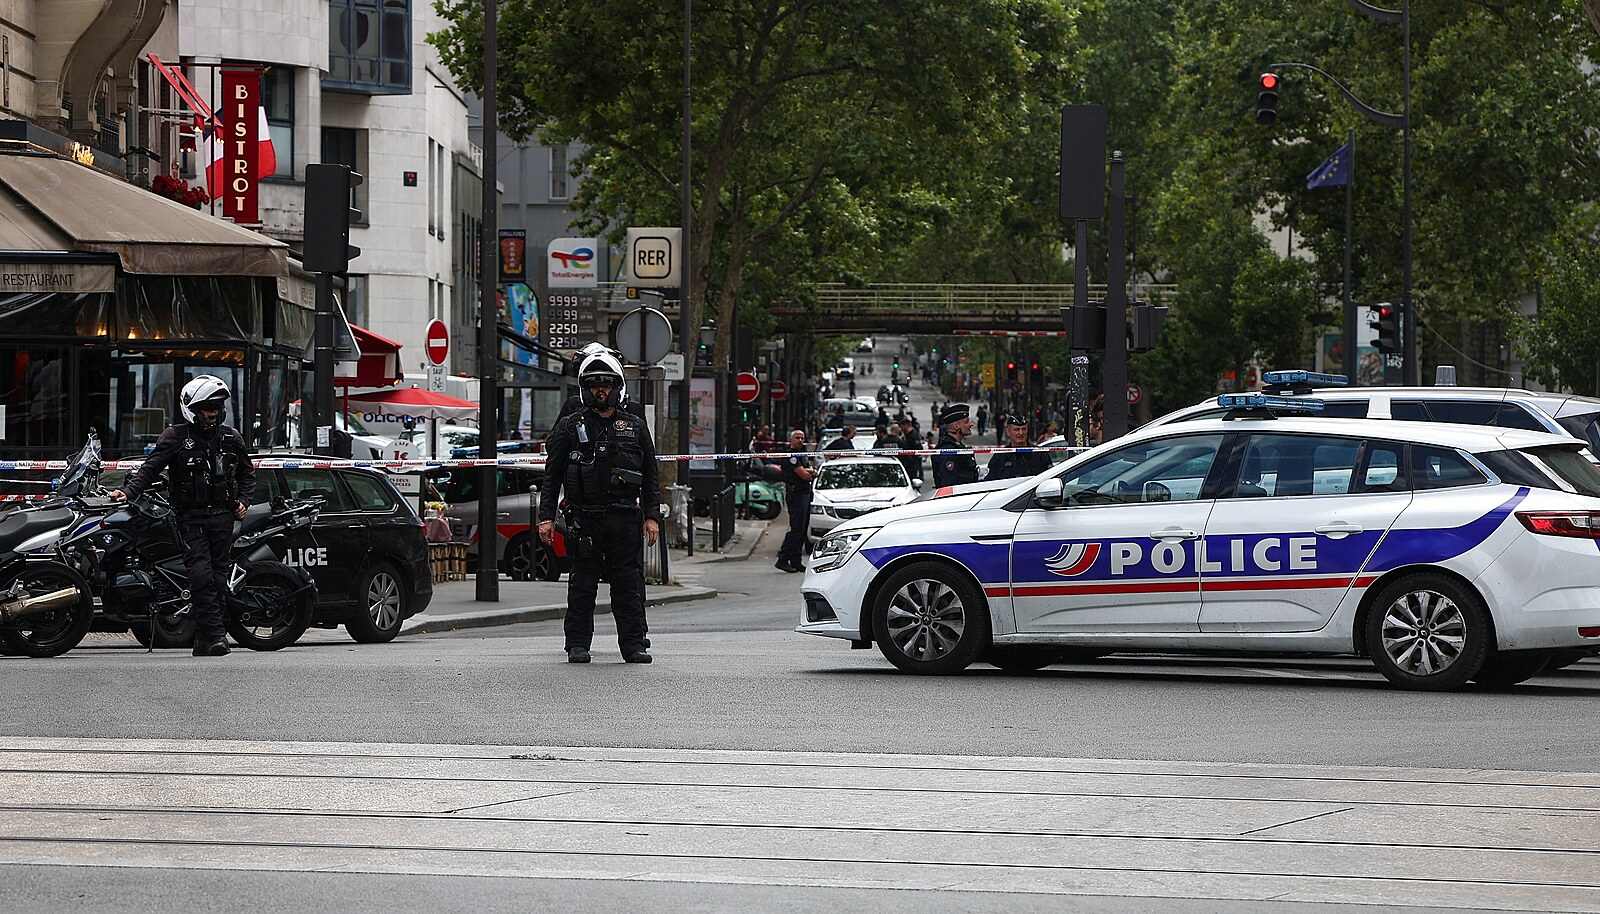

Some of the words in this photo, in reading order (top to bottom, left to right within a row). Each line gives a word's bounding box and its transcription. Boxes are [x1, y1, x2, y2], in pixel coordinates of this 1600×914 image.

[233, 84, 249, 212] BISTROT
[638, 250, 666, 266] RER
[2, 273, 74, 287] RESTAURANT
[551, 271, 594, 279] TotalEnergies
[549, 296, 578, 307] 9999
[549, 310, 578, 321] 9999
[549, 323, 578, 334] 2250
[549, 337, 578, 348] 2250
[1110, 536, 1318, 575] POLICE
